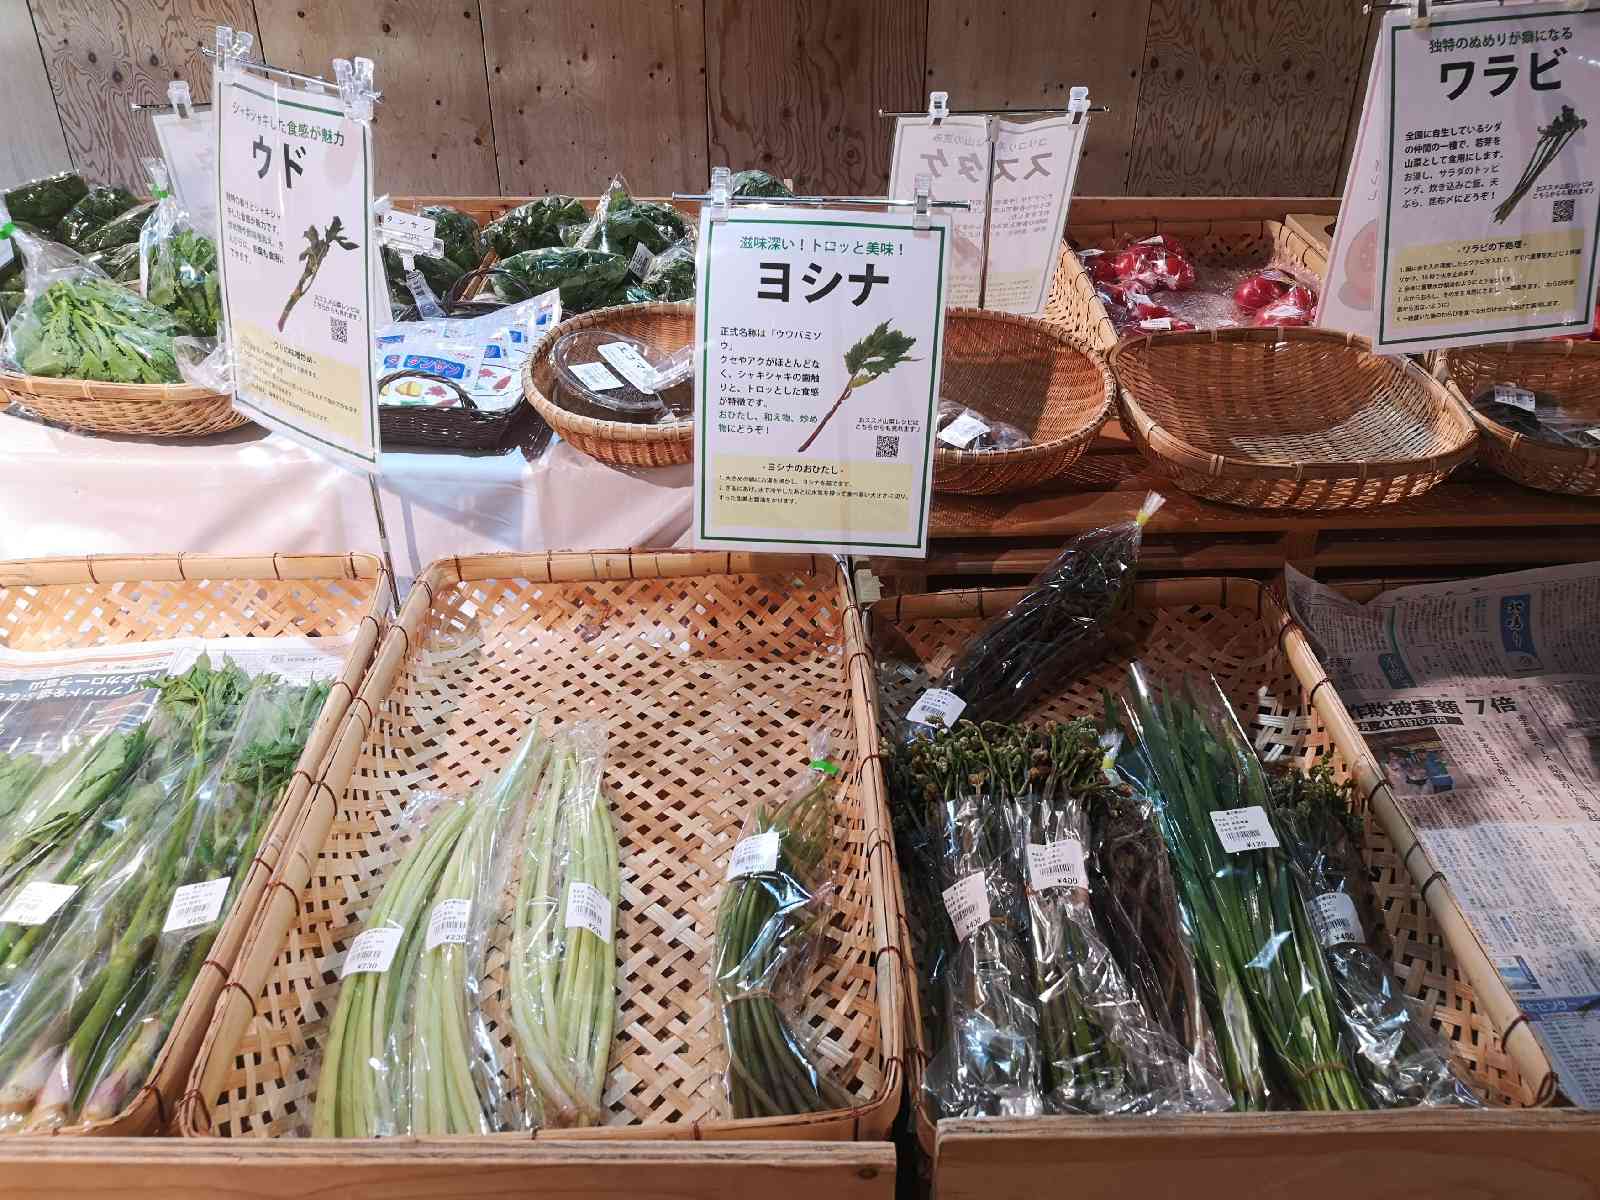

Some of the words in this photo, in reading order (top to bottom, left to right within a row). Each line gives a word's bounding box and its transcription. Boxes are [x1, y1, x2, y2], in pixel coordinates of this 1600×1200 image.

[1429, 26, 1573, 53] 独特のぬめりが癖になる
[1440, 46, 1569, 101] ワラビ
[253, 135, 307, 189] ウド
[740, 236, 904, 257] 滋味深い！トロッと美味！
[757, 262, 890, 307] ヨシナ
